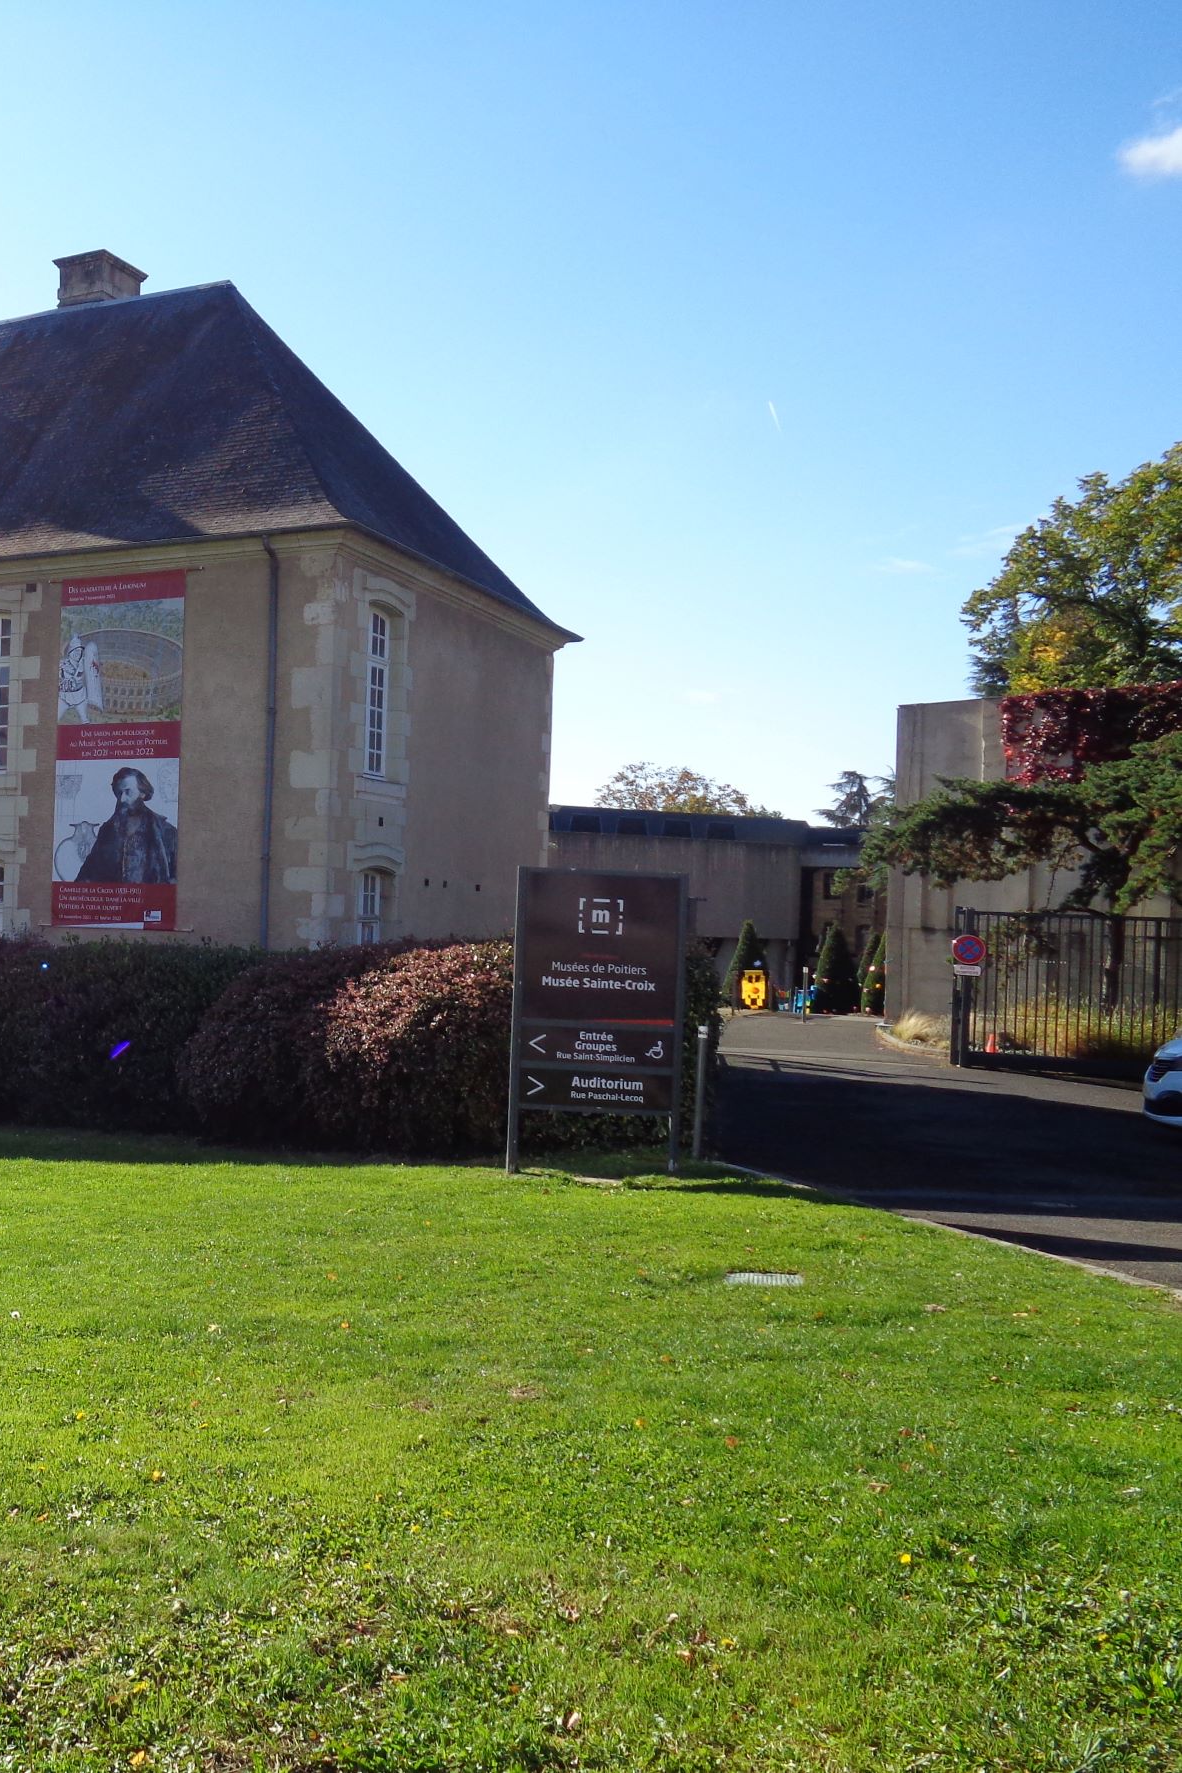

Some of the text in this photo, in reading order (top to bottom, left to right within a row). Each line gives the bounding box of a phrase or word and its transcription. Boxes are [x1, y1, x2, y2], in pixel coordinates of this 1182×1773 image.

[591, 909, 610, 923] m
[551, 961, 647, 976] Musées de Poitiers
[542, 976, 656, 992] Musée Sainte-Croix
[579, 1030, 614, 1042] Entrée
[574, 1040, 618, 1053] Groupes
[556, 1051, 636, 1064] Rue Saint-Simplicien
[571, 1076, 644, 1091] Auditorium
[570, 1090, 644, 1104] Rue Paschal-Lecoq
